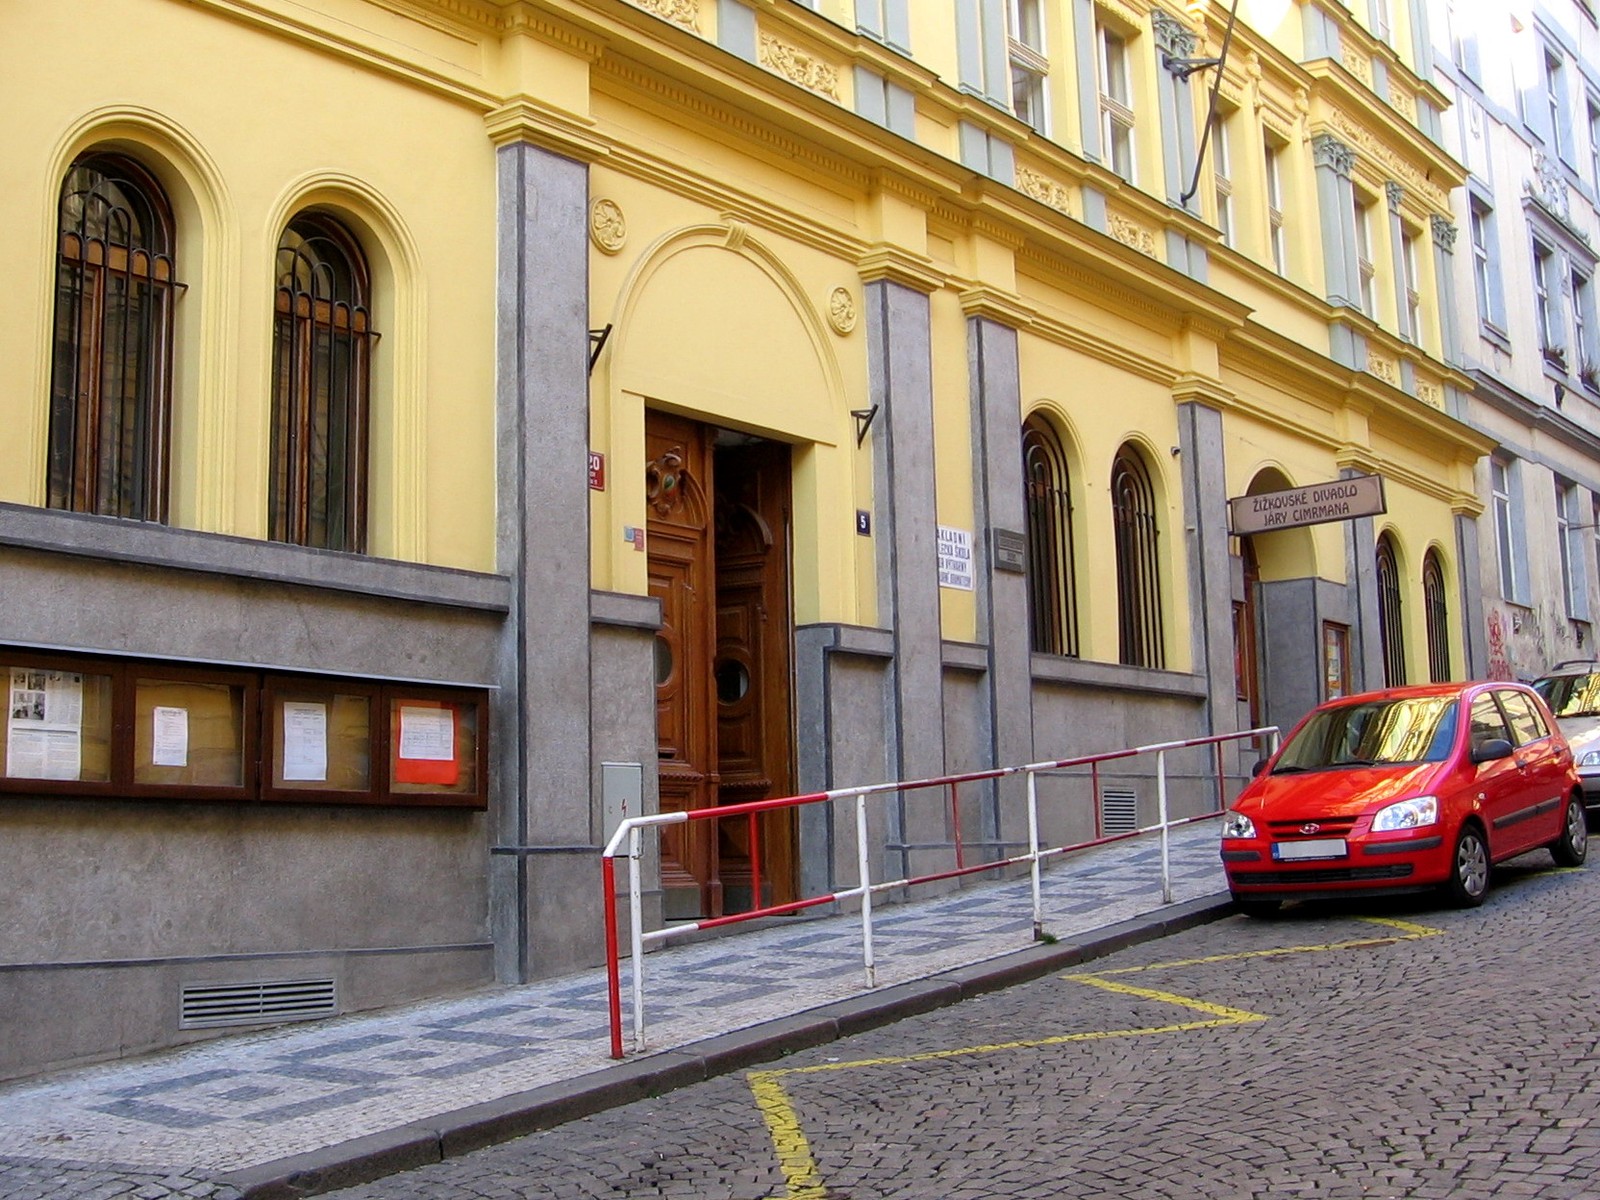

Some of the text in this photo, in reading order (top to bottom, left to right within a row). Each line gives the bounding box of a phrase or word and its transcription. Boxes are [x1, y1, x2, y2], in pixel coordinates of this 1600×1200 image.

[1252, 485, 1358, 512] ŽIŽKOVSKÉ DIVADLO
[860, 515, 866, 529] 5
[1264, 502, 1350, 526] JÁRY CIMRMANA
